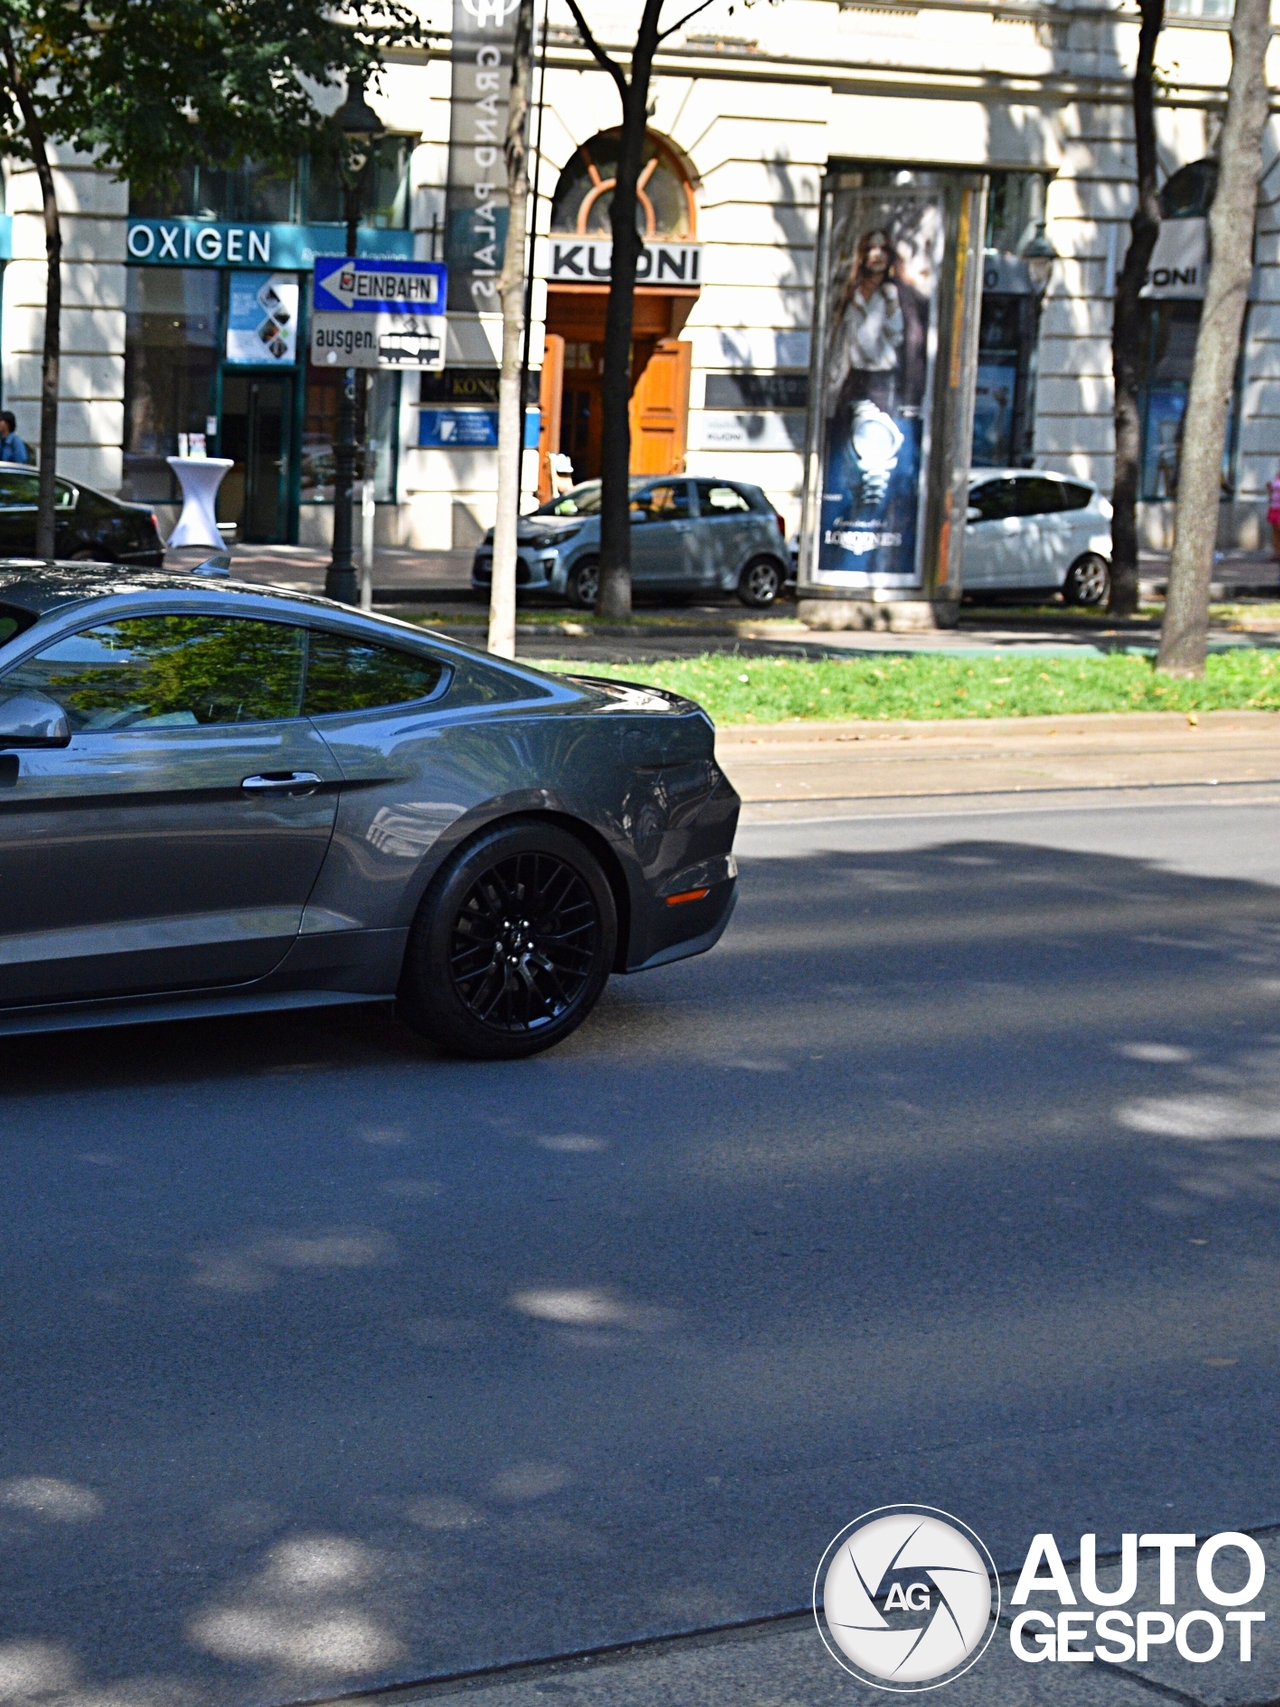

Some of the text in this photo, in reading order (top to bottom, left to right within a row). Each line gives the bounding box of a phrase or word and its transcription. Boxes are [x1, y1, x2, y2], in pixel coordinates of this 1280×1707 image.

[128, 224, 270, 263] OXIGEN
[357, 275, 432, 299] EINBAHN
[316, 328, 377, 354] ausgen.
